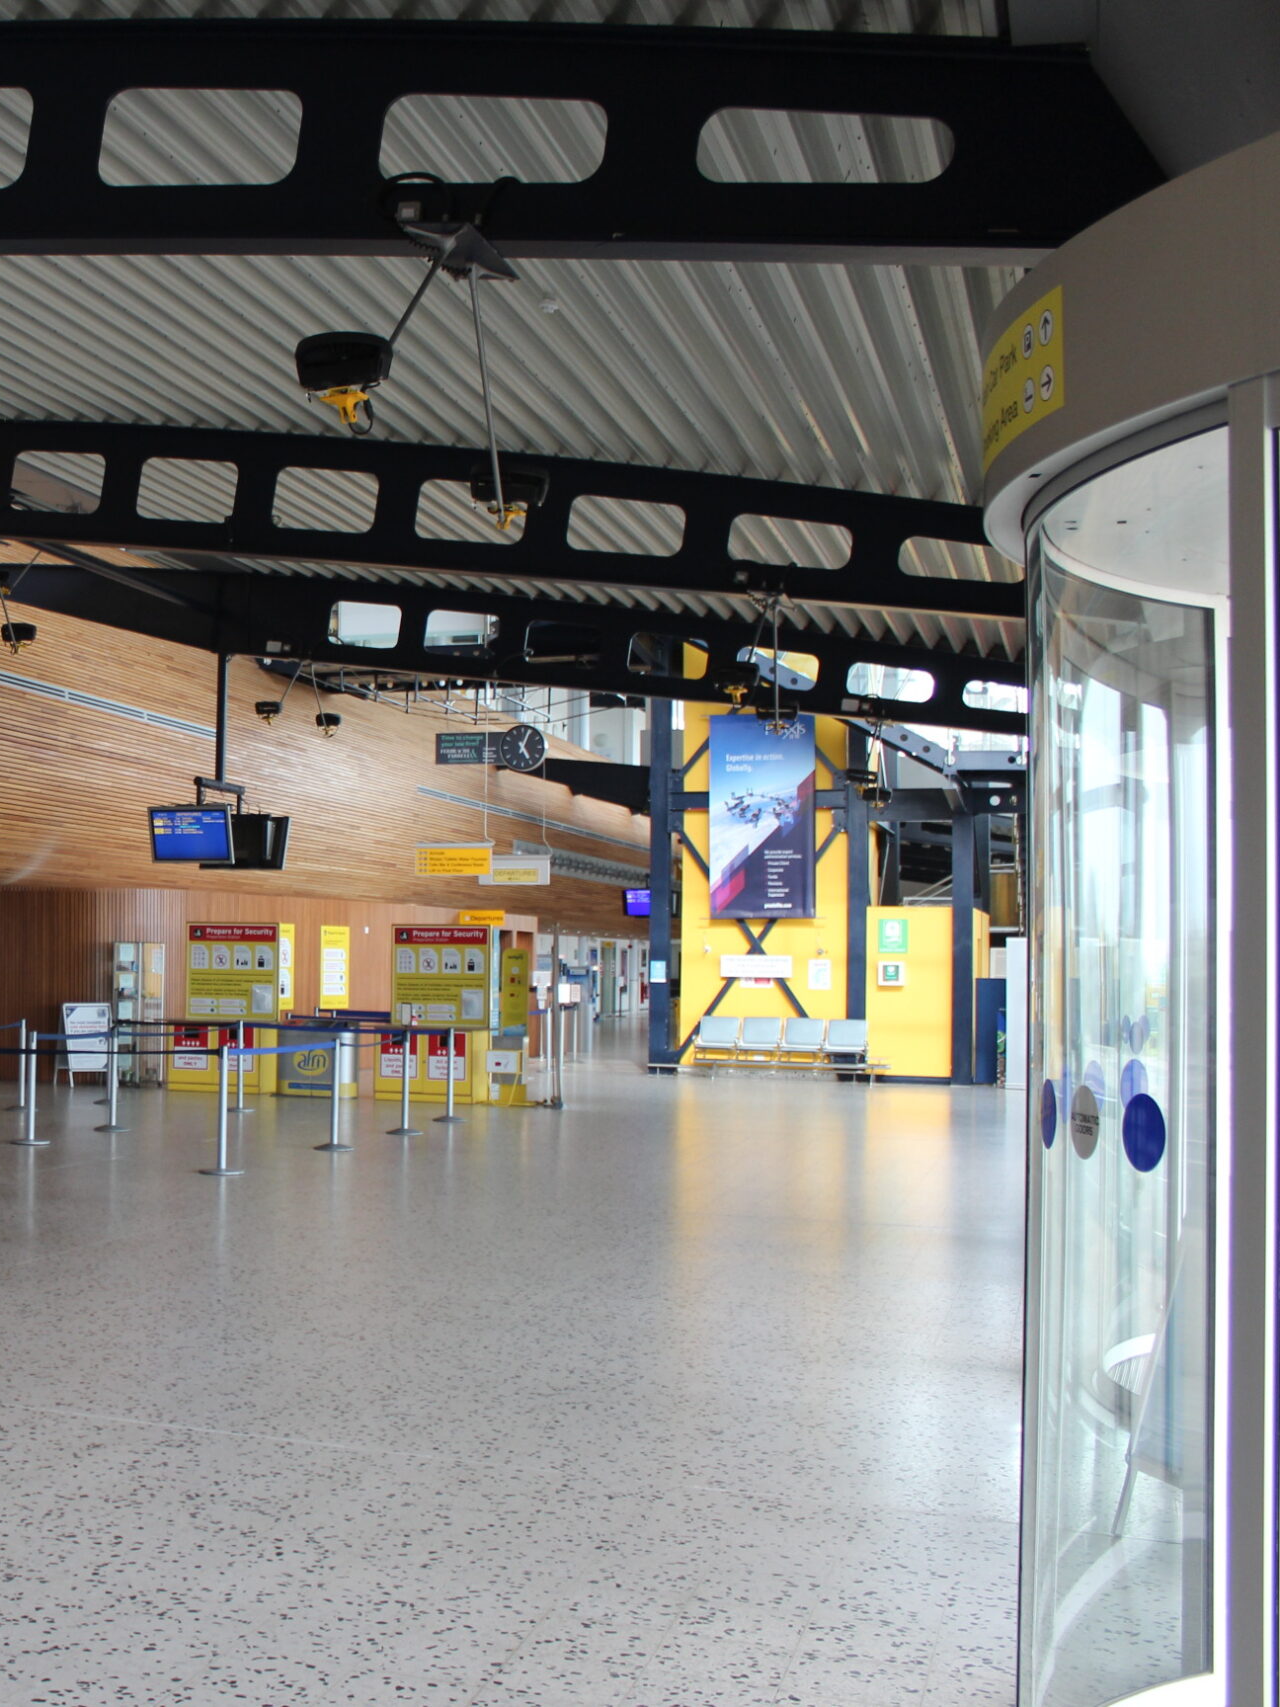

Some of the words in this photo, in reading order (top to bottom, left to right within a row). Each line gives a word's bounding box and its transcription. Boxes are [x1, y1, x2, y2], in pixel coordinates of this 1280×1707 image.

[206, 927, 232, 936] Prepare
[233, 927, 244, 935] for
[244, 928, 273, 937] Security
[412, 930, 440, 939] Prepare
[441, 930, 452, 938] for
[453, 930, 483, 939] Security
